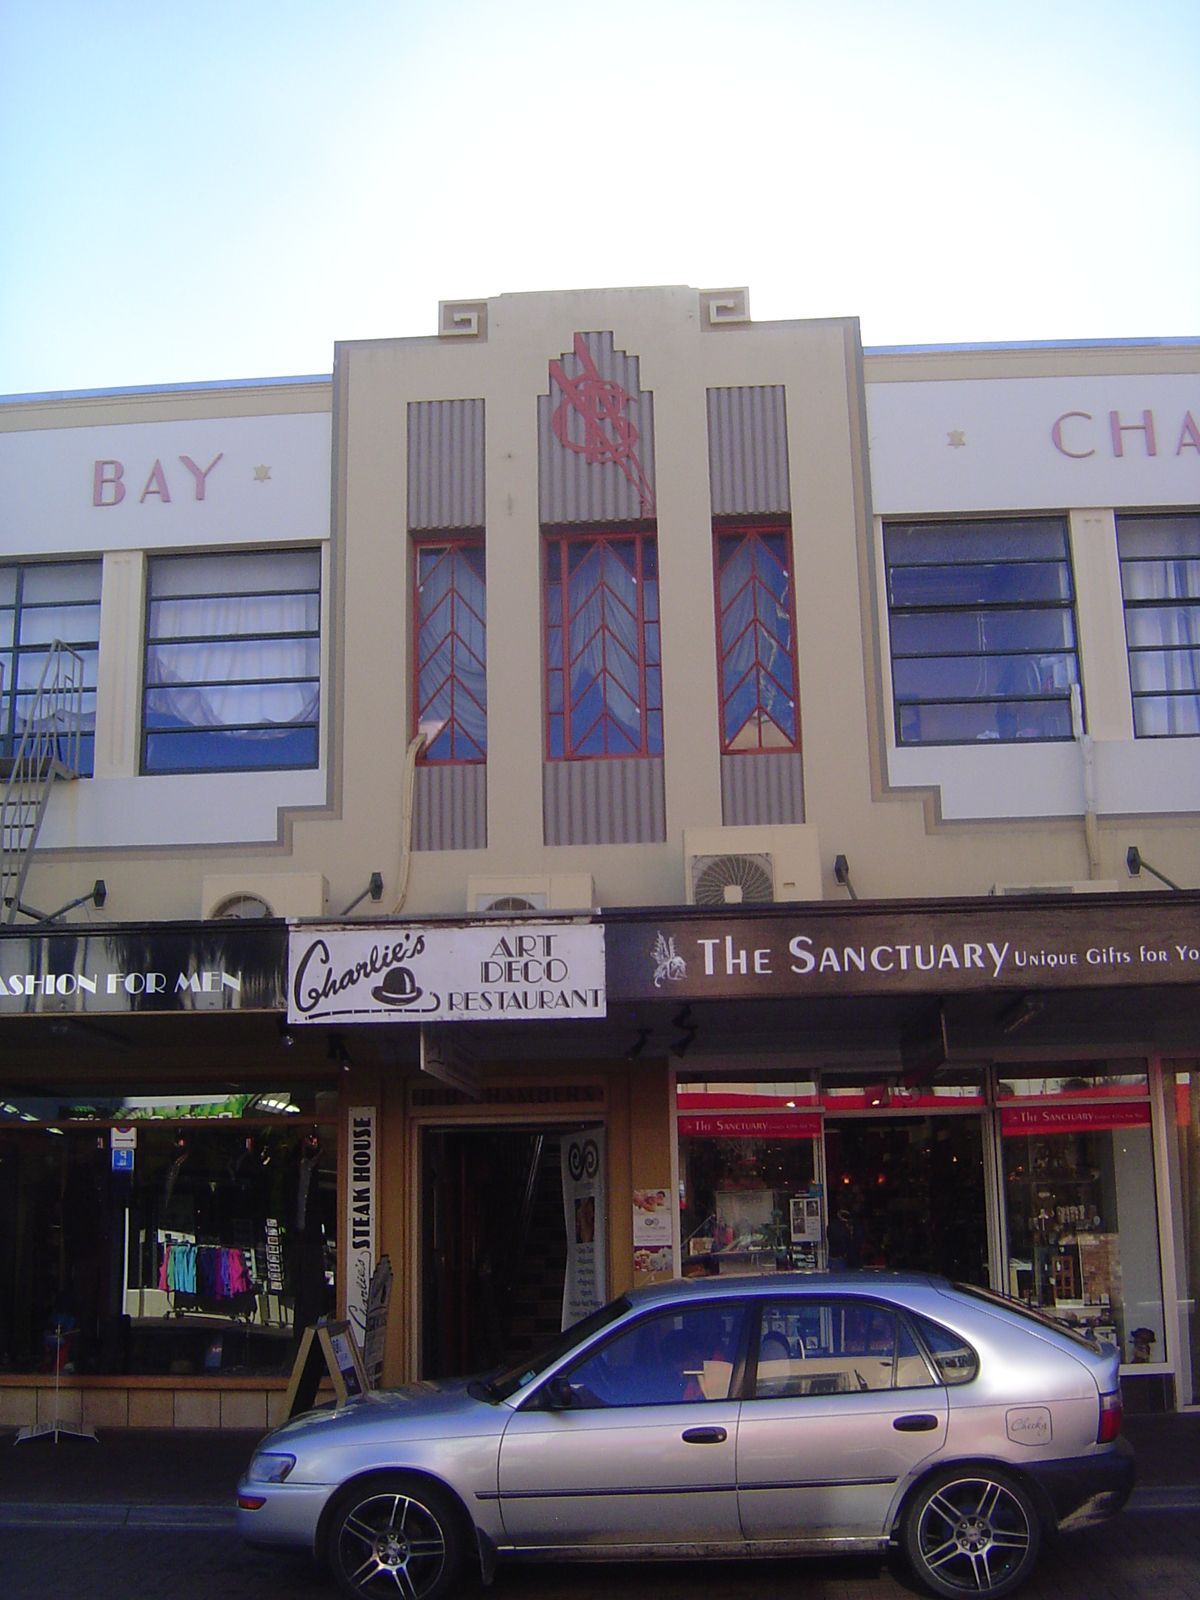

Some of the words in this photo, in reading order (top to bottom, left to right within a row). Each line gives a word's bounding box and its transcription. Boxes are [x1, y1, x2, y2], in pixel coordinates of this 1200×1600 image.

[92, 452, 224, 507] BAY
[489, 934, 558, 958] ART
[106, 972, 167, 995] FOR
[174, 970, 242, 993] MEN
[294, 933, 426, 1013] Charlie's
[480, 958, 568, 984] DECO
[448, 988, 604, 1012] RESTAURANT
[353, 1116, 372, 1183] HOUSE
[352, 1187, 371, 1250] STEAK
